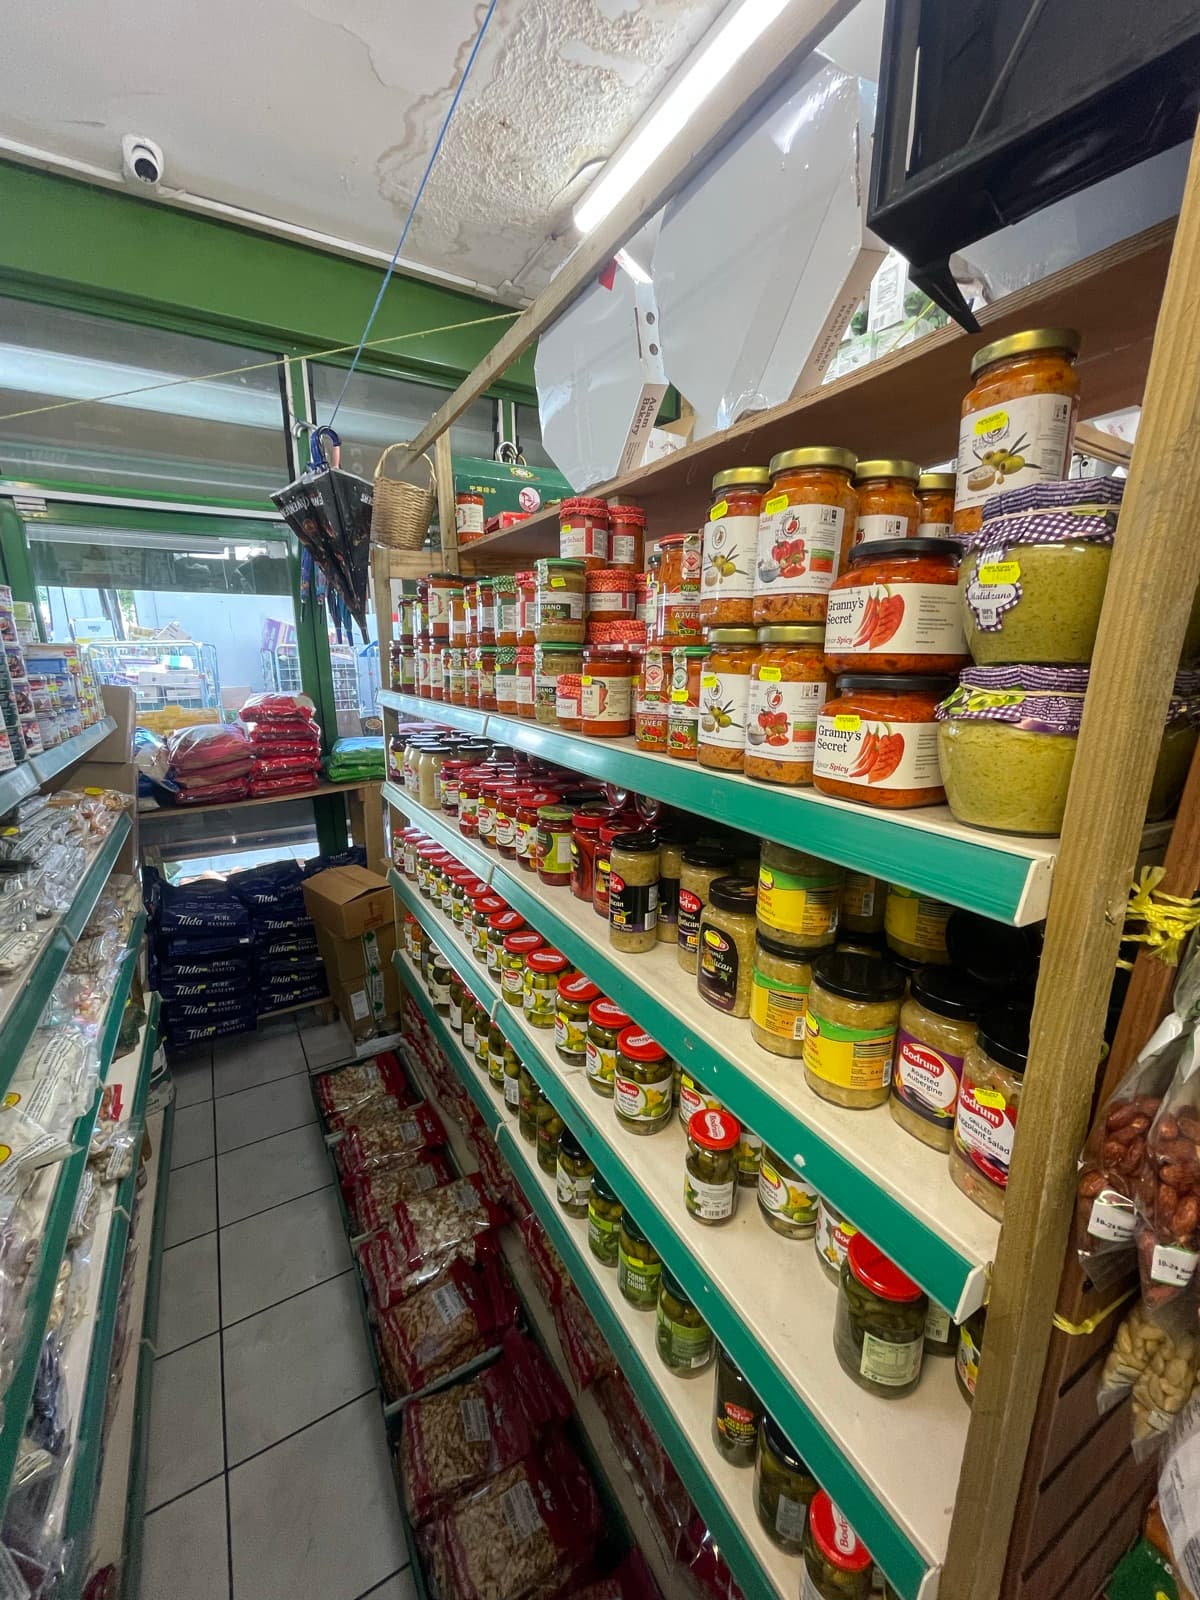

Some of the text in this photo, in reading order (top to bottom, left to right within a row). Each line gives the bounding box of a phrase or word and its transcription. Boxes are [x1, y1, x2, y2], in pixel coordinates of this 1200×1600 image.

[630, 398, 651, 436] Bakery
[641, 397, 657, 429] Adam
[828, 598, 864, 612] Granny's
[826, 614, 852, 625] Secret
[836, 636, 853, 646] Spicy
[818, 725, 862, 742] Granny's
[816, 739, 848, 753] Secret
[828, 762, 849, 775] Spicy
[254, 894, 278, 904] Tilda
[175, 914, 203, 926] Tilda
[264, 920, 288, 929] Tilda
[174, 965, 202, 975] Tilda
[173, 984, 202, 996] Tilda
[272, 993, 294, 1004] Tilda
[182, 1005, 208, 1015] Tilda
[186, 1028, 213, 1040] Tilda
[903, 1045, 940, 1074] Bodrum
[911, 1068, 940, 1087] Roasted
[907, 1073, 943, 1097] Aubergine
[960, 1088, 999, 1124] Bodrum
[710, 1115, 719, 1138] Bodrum
[987, 1134, 1010, 1156] Salad
[840, 1519, 849, 1548] Bodr
